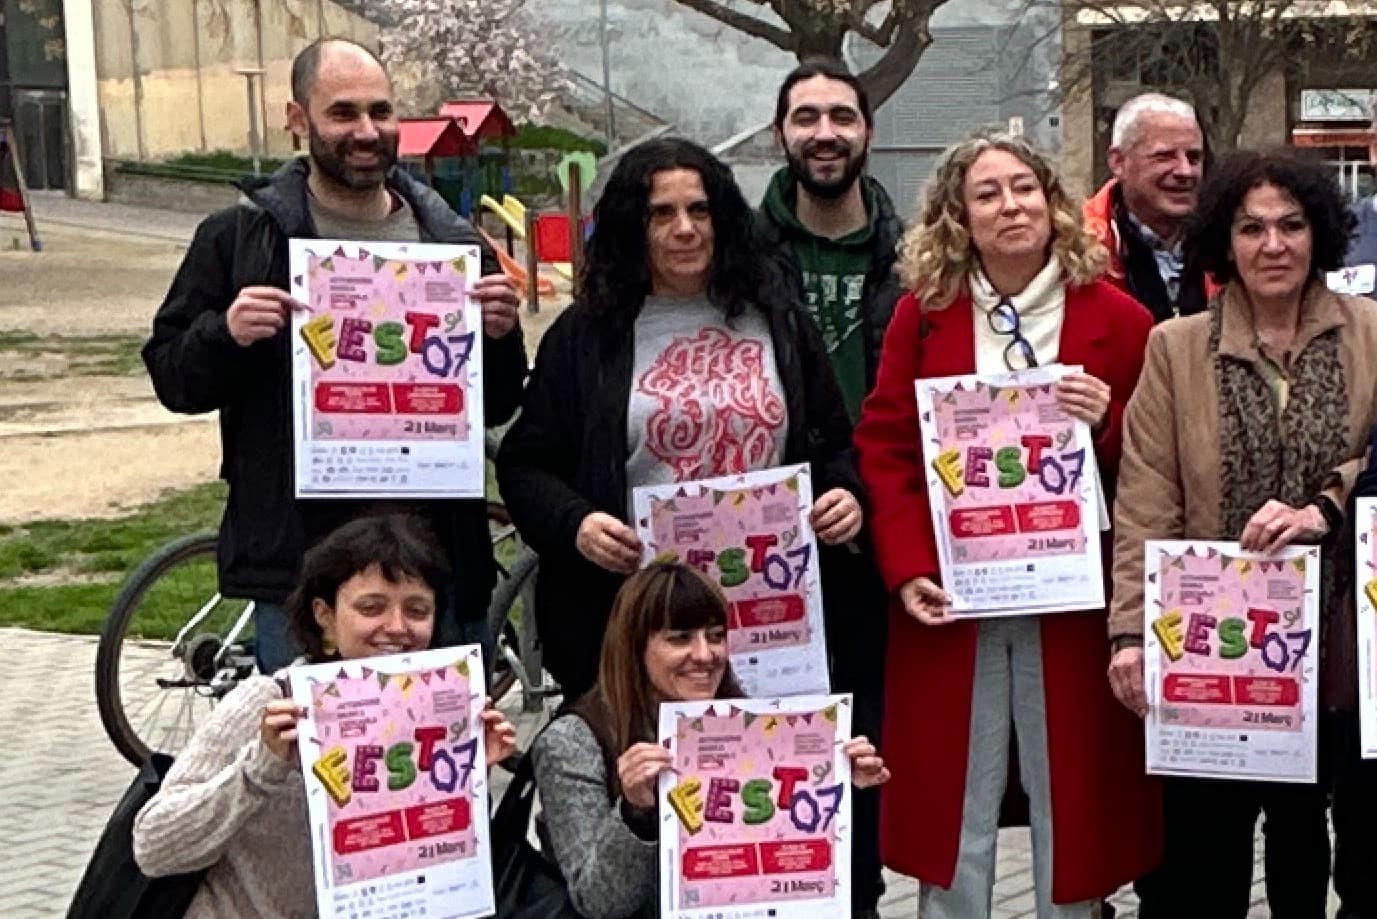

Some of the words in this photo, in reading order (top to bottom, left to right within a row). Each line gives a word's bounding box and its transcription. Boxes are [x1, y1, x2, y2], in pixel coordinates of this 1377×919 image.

[300, 311, 441, 371] FEST
[422, 331, 475, 377] 07
[931, 435, 1052, 498] FEST
[1039, 447, 1086, 495] 07
[763, 543, 811, 590] 07
[1151, 607, 1279, 662] FEST
[1262, 628, 1312, 673] 07
[312, 726, 447, 808] FEST
[430, 738, 477, 793] 07
[668, 766, 808, 836] FEST
[790, 782, 844, 833] 07
